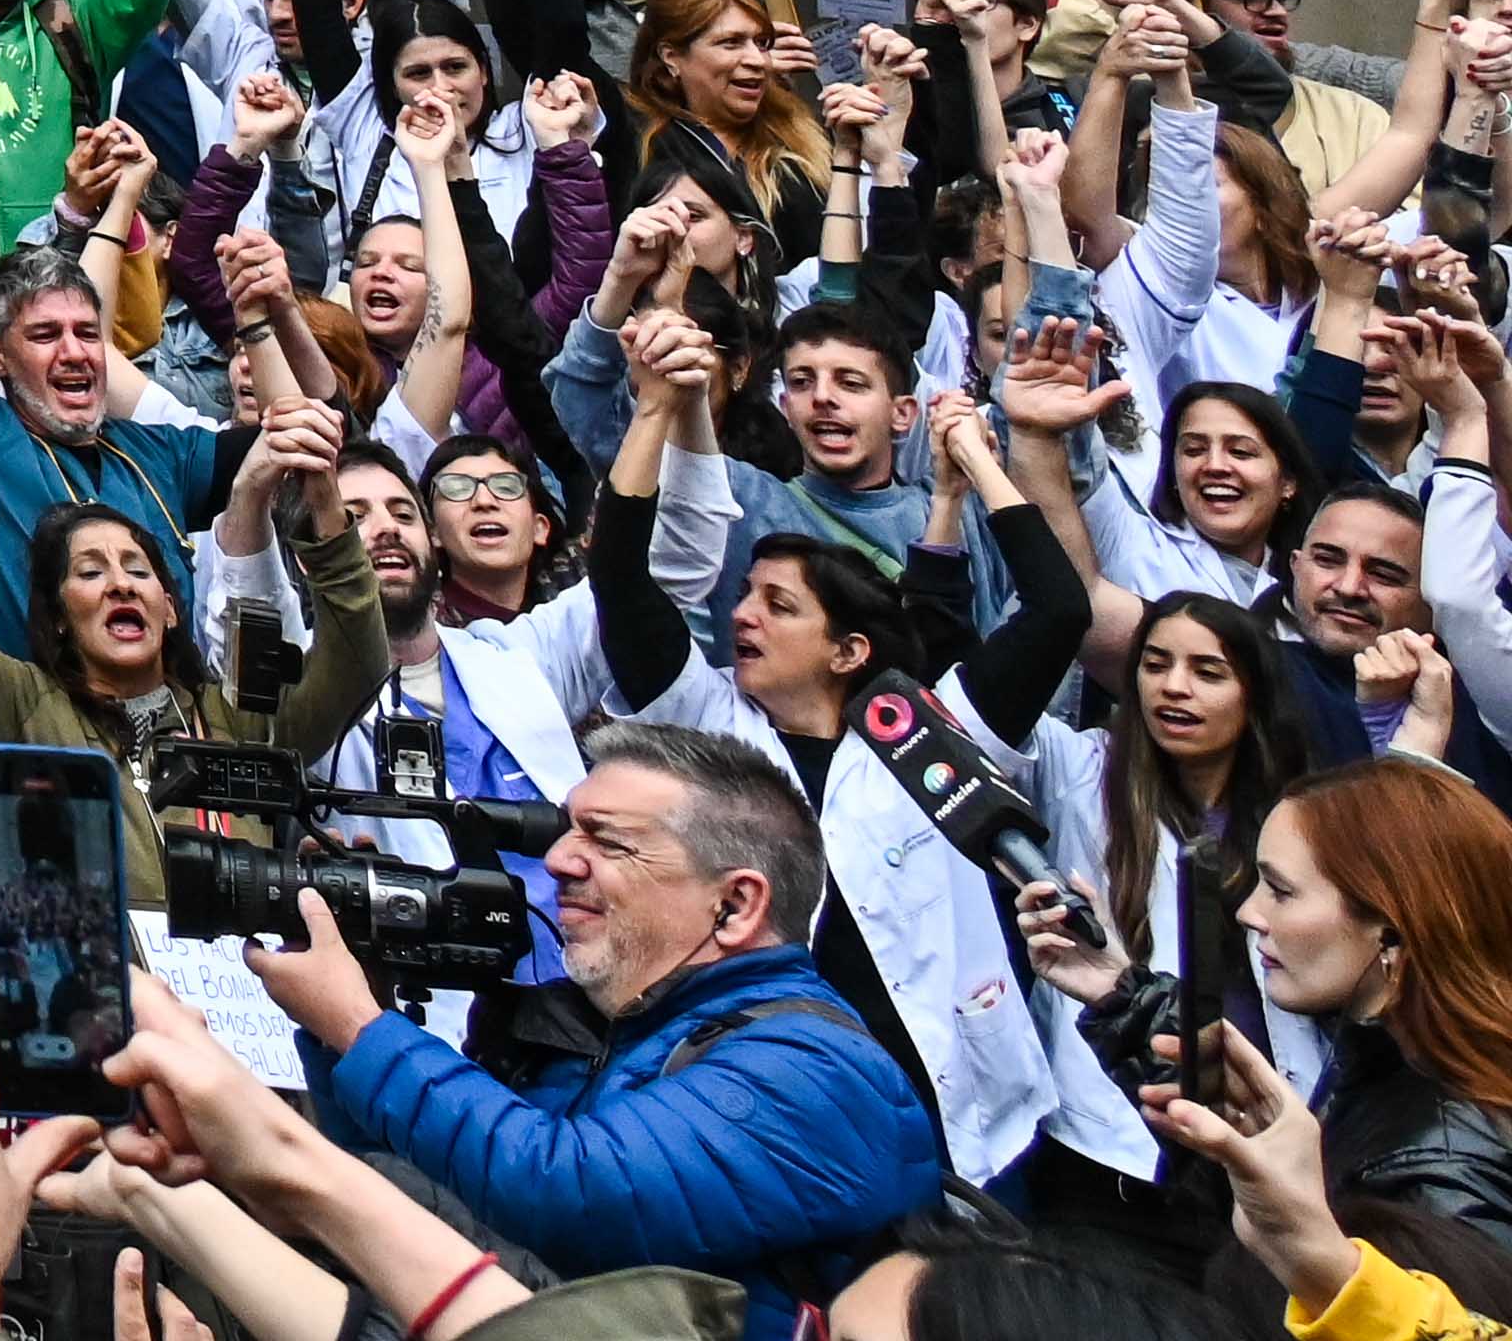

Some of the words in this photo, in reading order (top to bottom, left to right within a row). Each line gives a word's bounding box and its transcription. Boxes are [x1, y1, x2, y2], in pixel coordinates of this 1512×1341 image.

[934, 777, 981, 822] noticias
[485, 912, 510, 923] JVC
[146, 927, 189, 957] LOS
[205, 1009, 257, 1036] EMOS
